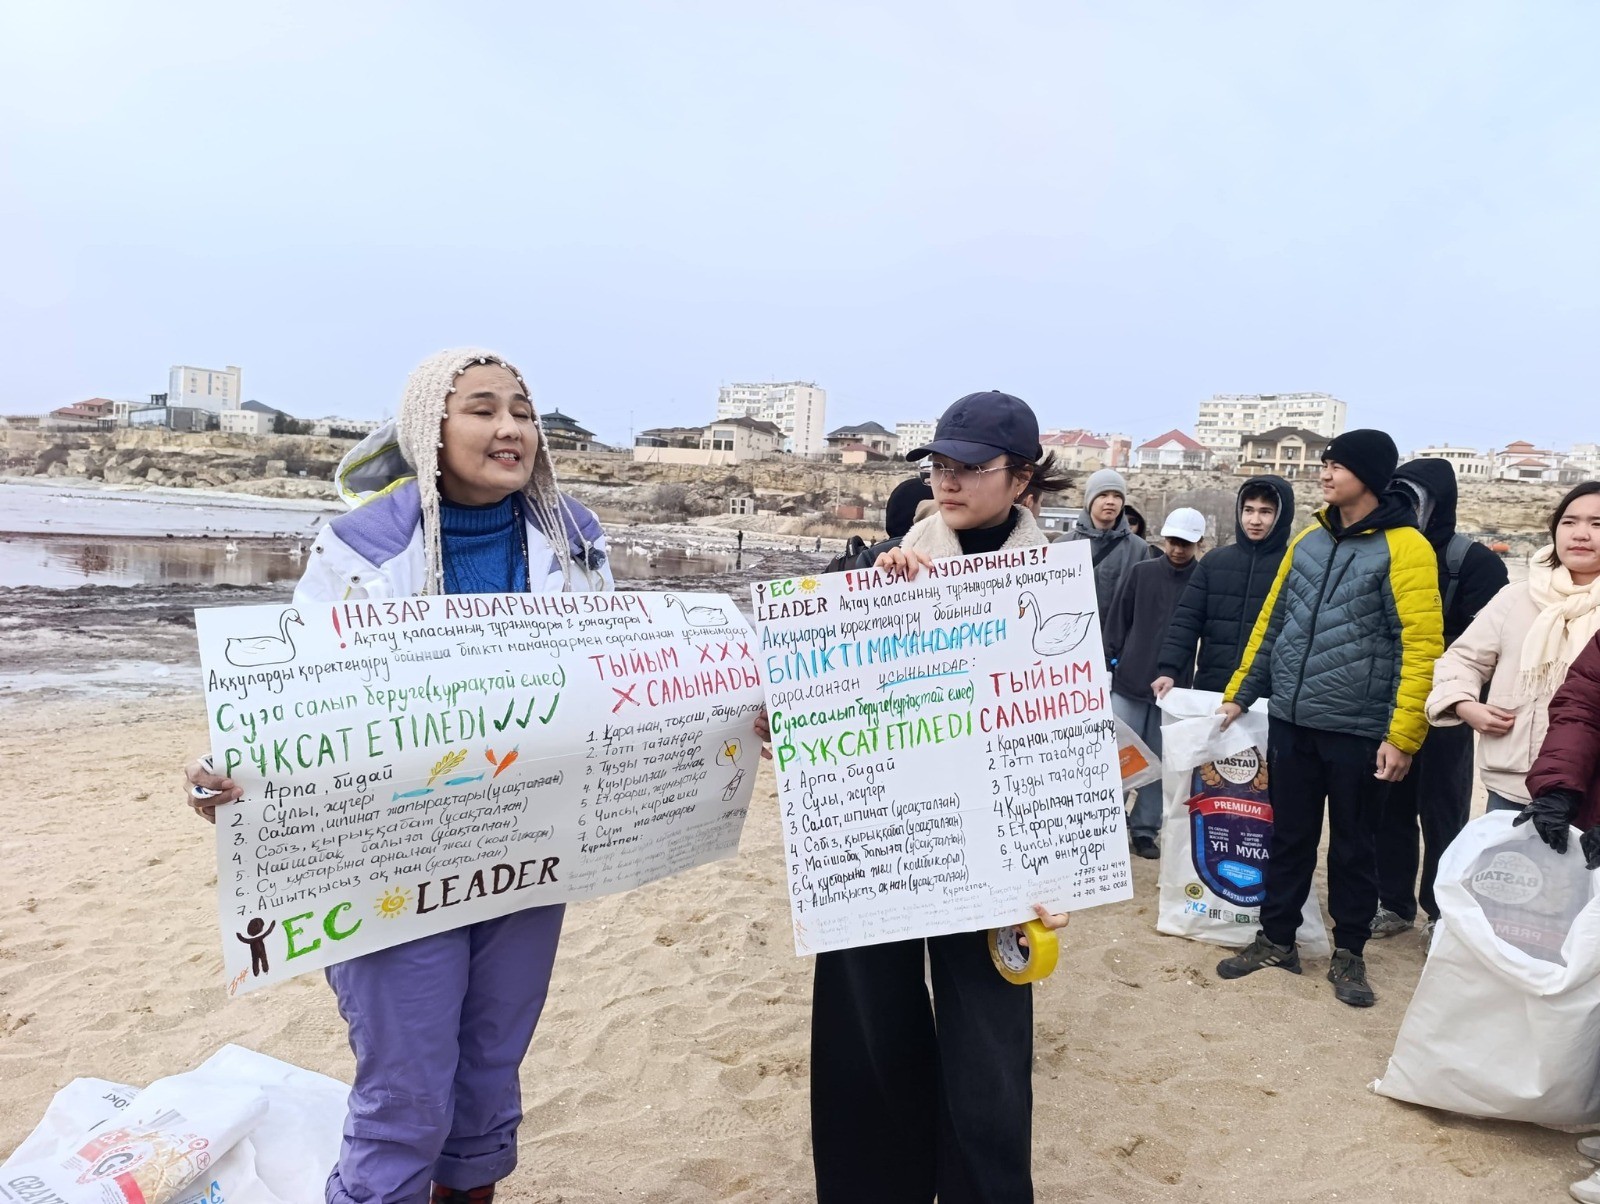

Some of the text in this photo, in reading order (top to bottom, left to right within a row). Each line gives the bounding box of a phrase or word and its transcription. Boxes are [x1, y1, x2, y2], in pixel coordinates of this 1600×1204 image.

[757, 597, 828, 621] LEADER
[839, 595, 869, 615] Ақтау
[873, 586, 941, 606] қаласының
[354, 631, 397, 650] Ақтау
[402, 622, 485, 641] қаласының
[762, 625, 837, 655] Аққуларды
[932, 602, 992, 621] бойынша
[208, 669, 294, 699] Аққуларды
[393, 647, 452, 664] бойынша
[507, 637, 602, 658] мамандармен
[588, 647, 679, 681] ТЫЙЫМ
[989, 660, 1092, 697] ТЫЙЫМ
[646, 664, 761, 707] САЛЫНАДЫ
[772, 678, 860, 710] сараланған
[216, 702, 284, 744] Суға
[294, 695, 358, 718] салып
[980, 687, 1104, 733] САЛЫНАДЫ
[586, 732, 599, 743] 1.
[586, 747, 598, 759] 2.
[643, 746, 702, 765] тағамдар
[1039, 742, 1102, 767] тағамдар
[333, 764, 393, 793] бидай
[847, 758, 896, 784] бидай
[1048, 763, 1109, 788] тағамдар
[844, 806, 888, 823] шпинат
[1005, 788, 1115, 823] Қуырылған тамақ
[1213, 801, 1262, 815] PREMIUM
[234, 833, 248, 846] 3.
[326, 810, 381, 829] шпинат
[1055, 842, 1106, 865] өнімдері
[1235, 845, 1270, 860] МУКА
[235, 887, 250, 897] 6.
[257, 879, 278, 898] Су
[443, 840, 471, 851] жем
[871, 863, 892, 877] жем
[236, 905, 252, 916] 7.
[369, 870, 389, 883] ақ
[394, 864, 421, 875] нан
[416, 856, 561, 914] LEADER
[878, 883, 889, 895] ақ
[890, 880, 906, 890] нан
